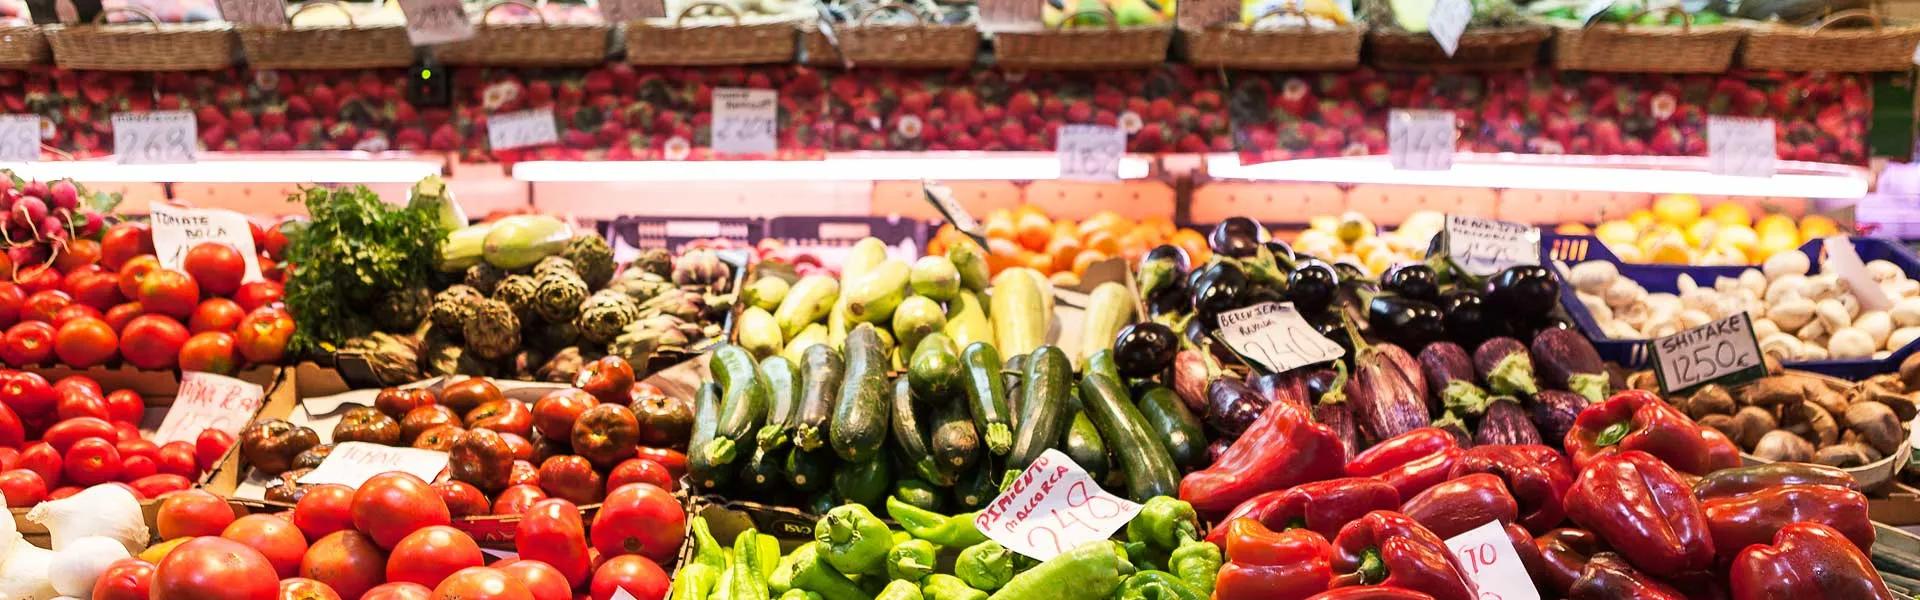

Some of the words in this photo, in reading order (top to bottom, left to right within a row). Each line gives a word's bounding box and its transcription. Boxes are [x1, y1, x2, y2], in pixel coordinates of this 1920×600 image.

[151, 211, 208, 226] TOMATE
[1662, 315, 1741, 354] SHITAKE
[976, 456, 1049, 532] PIMIENTO
[1004, 465, 1070, 534] MALLORCA
